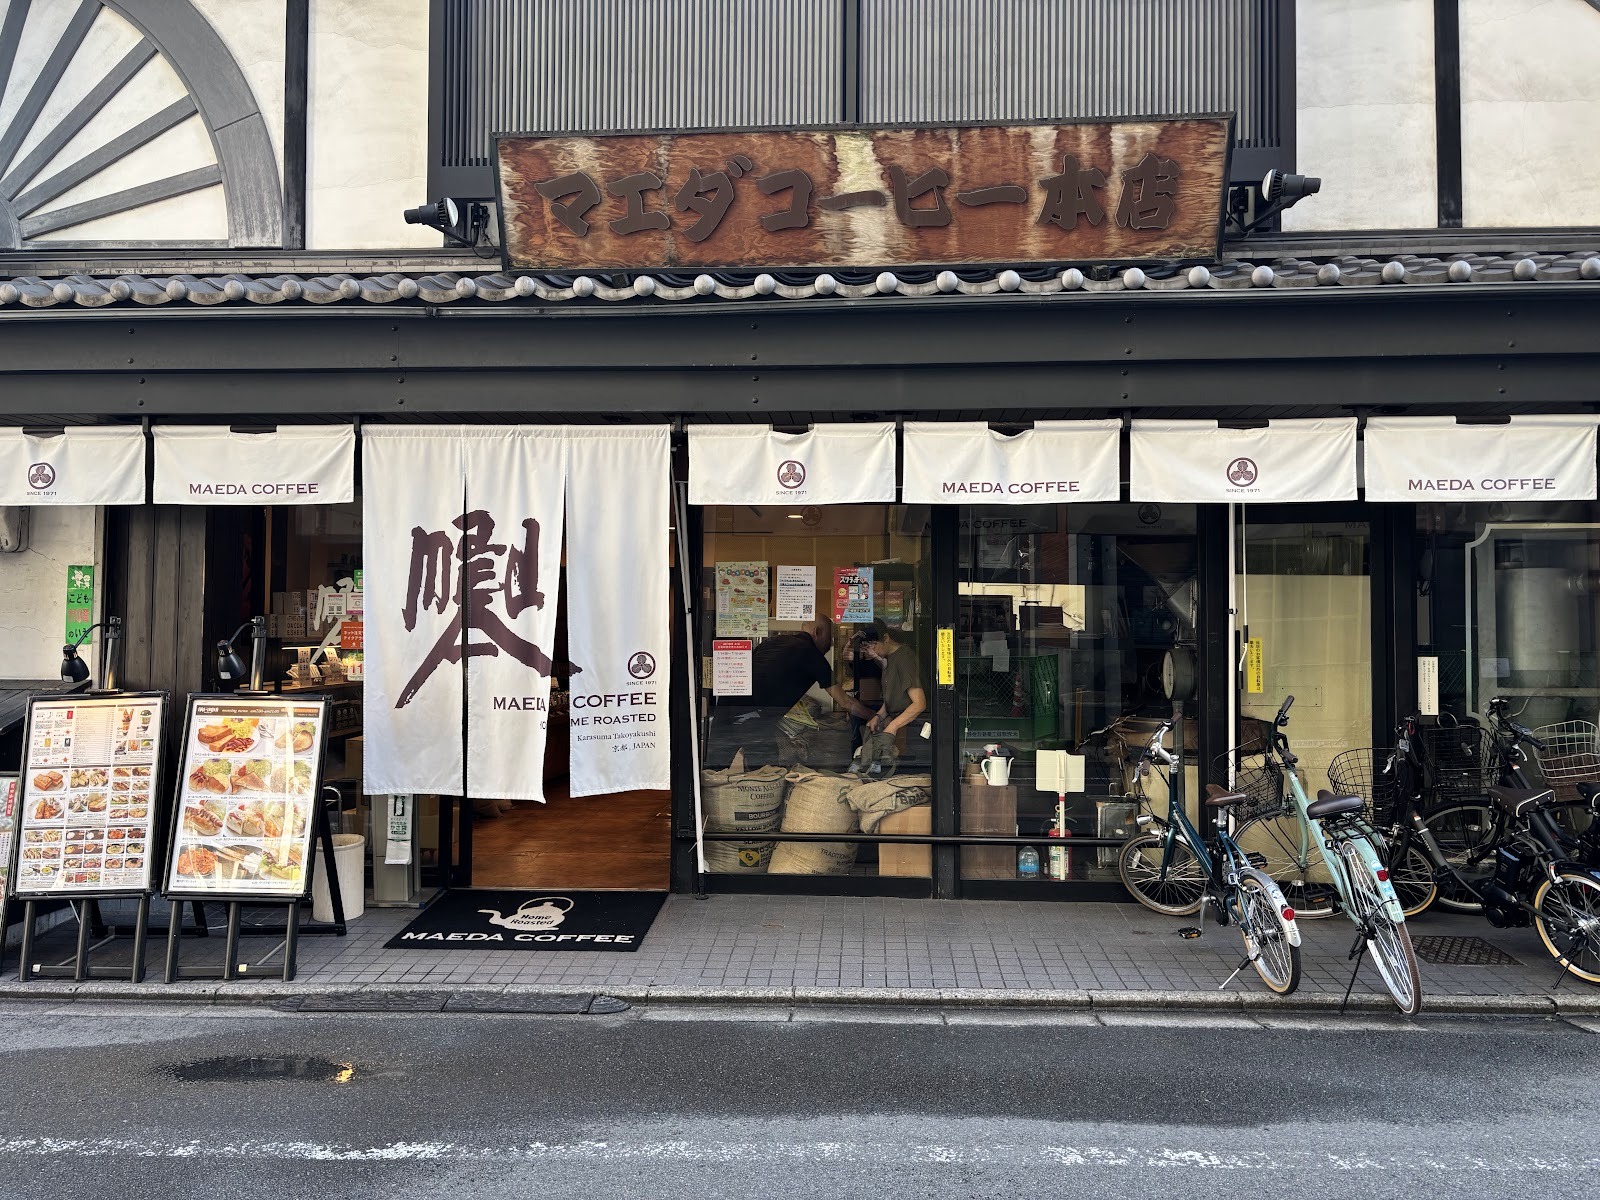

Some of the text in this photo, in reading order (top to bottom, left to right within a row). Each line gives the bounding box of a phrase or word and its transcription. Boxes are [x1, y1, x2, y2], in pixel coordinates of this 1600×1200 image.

[533, 152, 1182, 243] マエダコーヒー本店
[189, 482, 320, 495] MAEDA COFFEE
[942, 480, 1080, 494] MAEDA COFFEE
[1408, 477, 1557, 491] MAEDA COFFEE
[69, 593, 89, 604] こども
[572, 692, 657, 709] COFFEE
[593, 713, 657, 725] ROASTED
[577, 731, 656, 742] Karasuma Takoyakushi
[632, 742, 656, 750] JAPAN
[401, 931, 635, 944] MAEDA COFFEE
